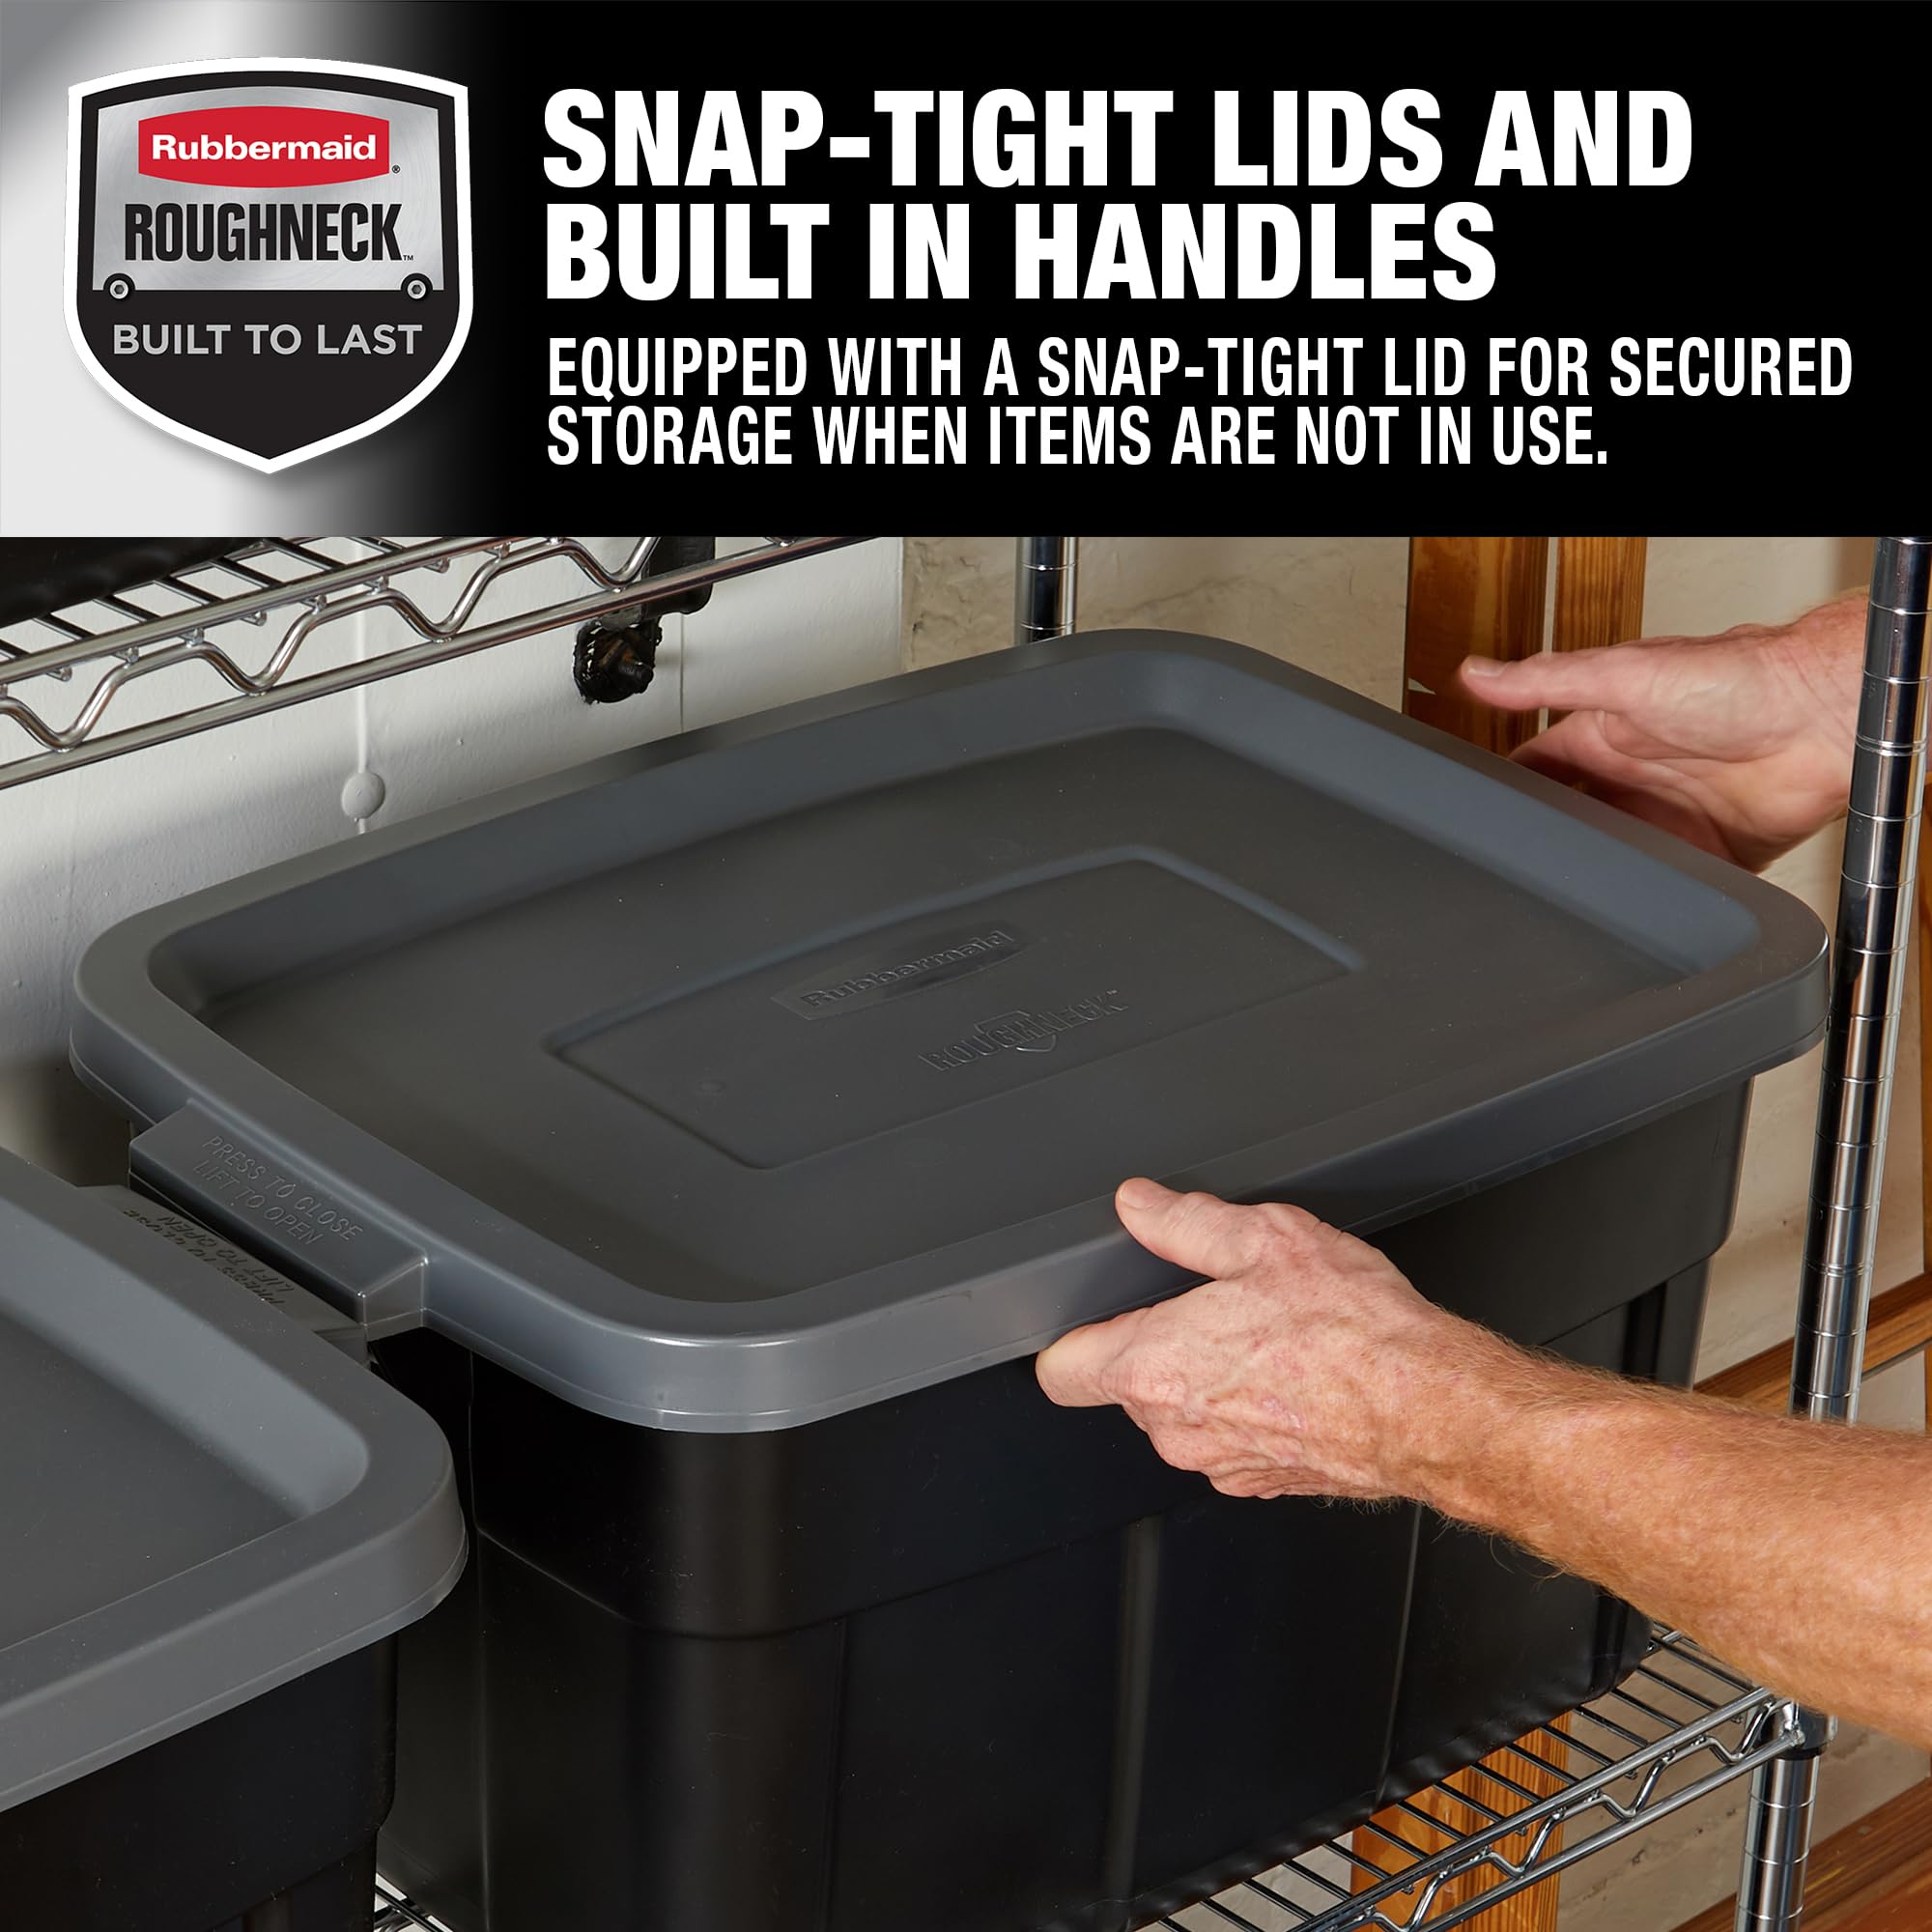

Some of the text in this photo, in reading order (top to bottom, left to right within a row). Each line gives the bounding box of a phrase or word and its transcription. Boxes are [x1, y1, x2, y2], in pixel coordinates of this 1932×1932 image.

[801, 929, 1015, 1007] Rubbermaid
[193, 1160, 324, 1245] LIFT TO OPEN
[202, 1135, 363, 1241] PRESS TO CLOSE
